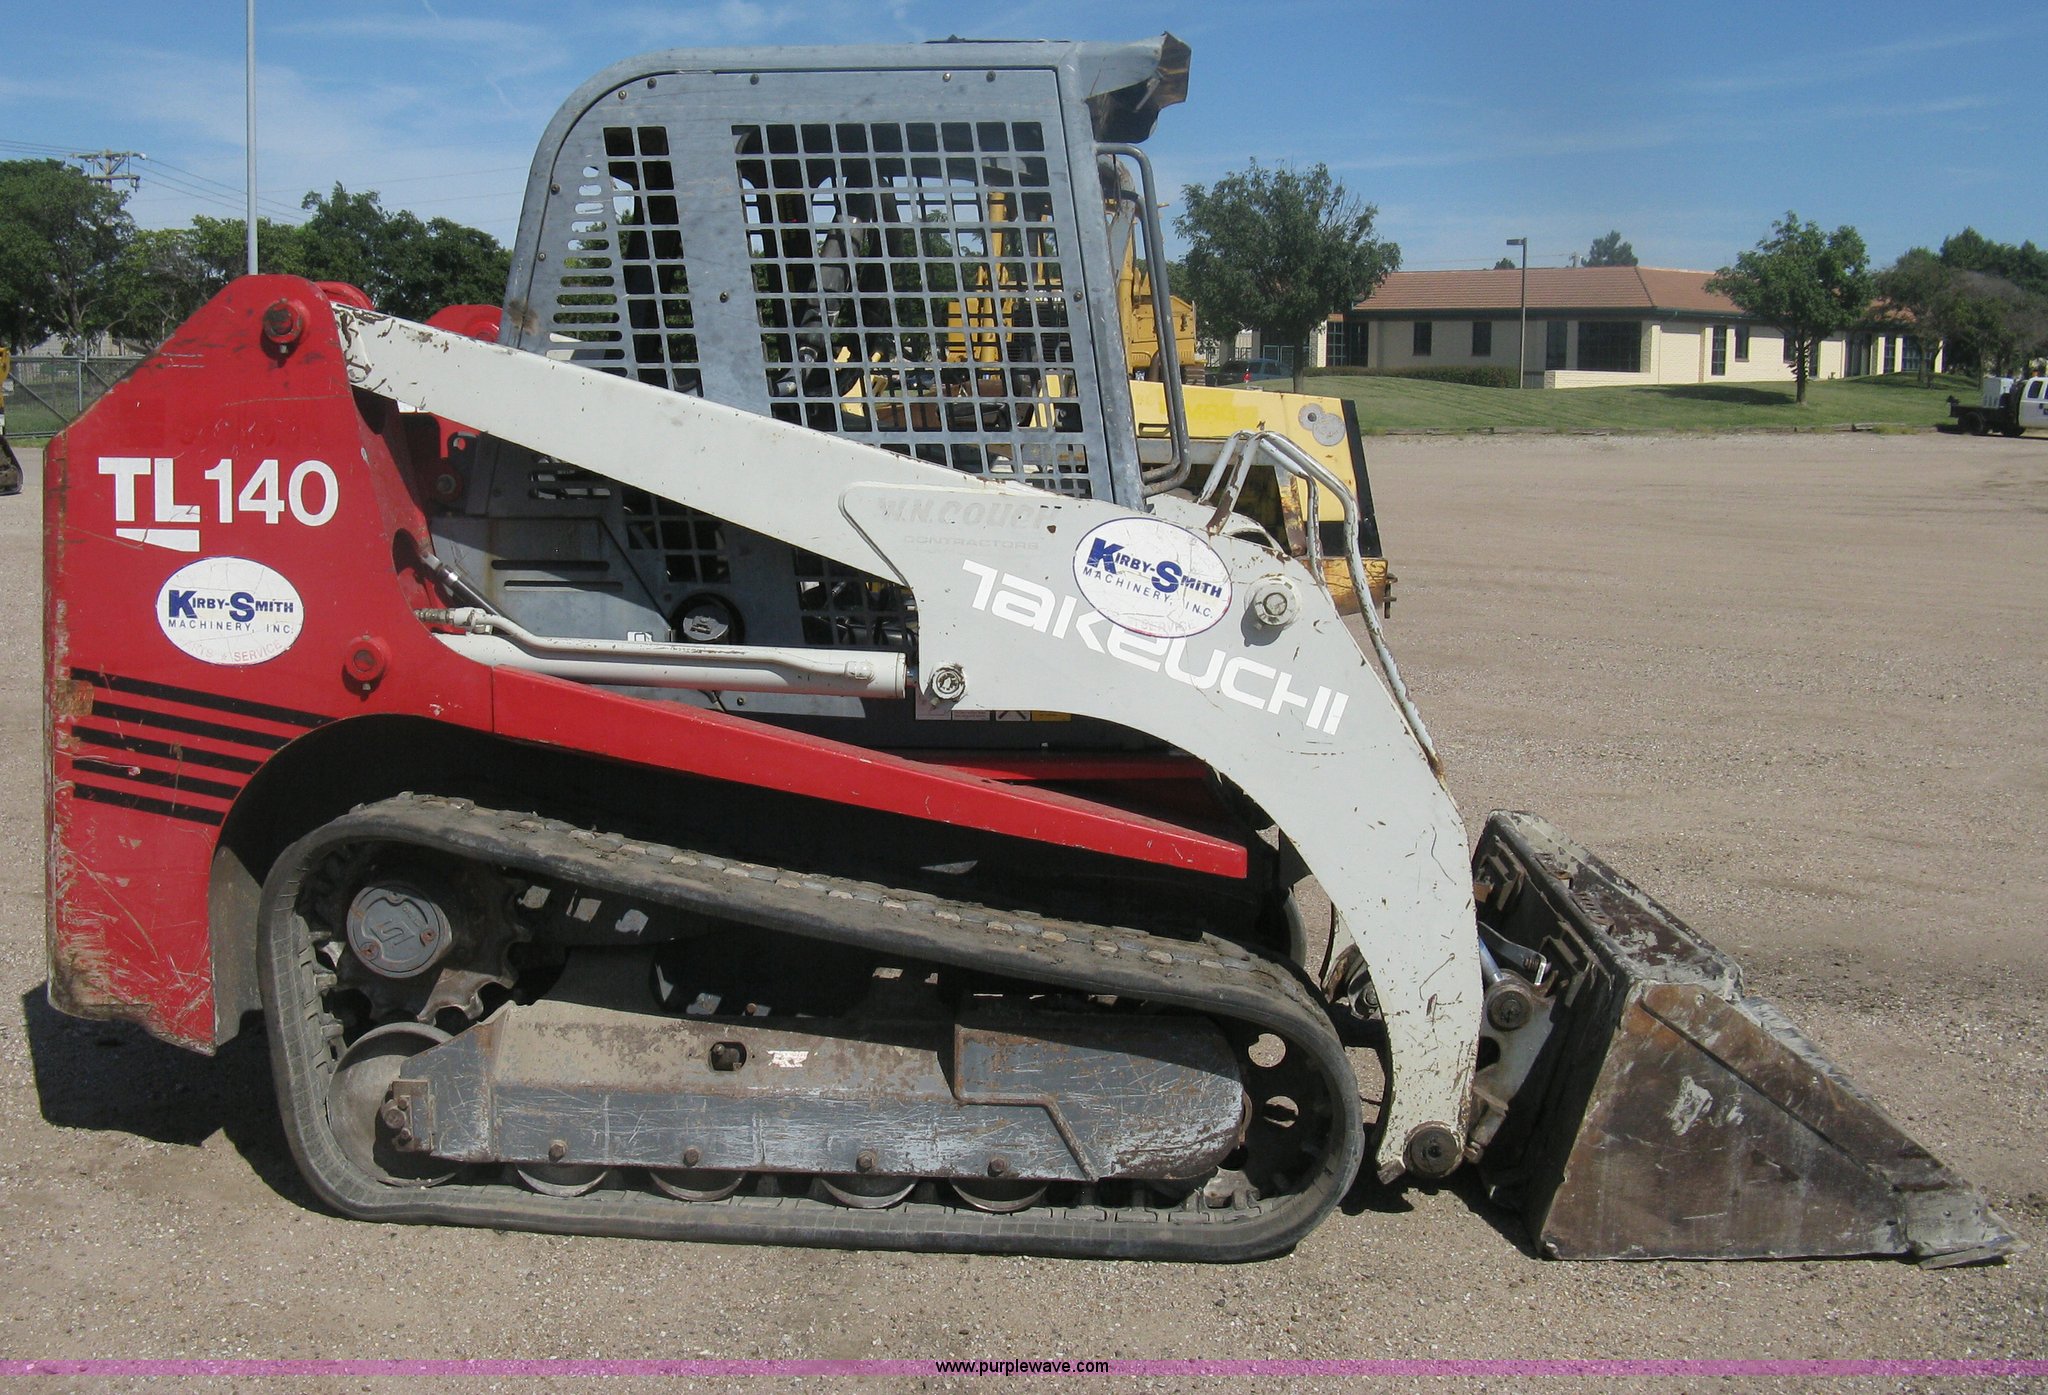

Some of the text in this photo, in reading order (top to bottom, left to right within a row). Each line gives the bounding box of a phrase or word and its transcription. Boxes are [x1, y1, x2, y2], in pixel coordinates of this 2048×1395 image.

[904, 535, 1040, 550] CONTRACTORS
[1184, 602, 1214, 619] INC.
[266, 623, 294, 634] INC.
[234, 638, 283, 662] SERVICE
